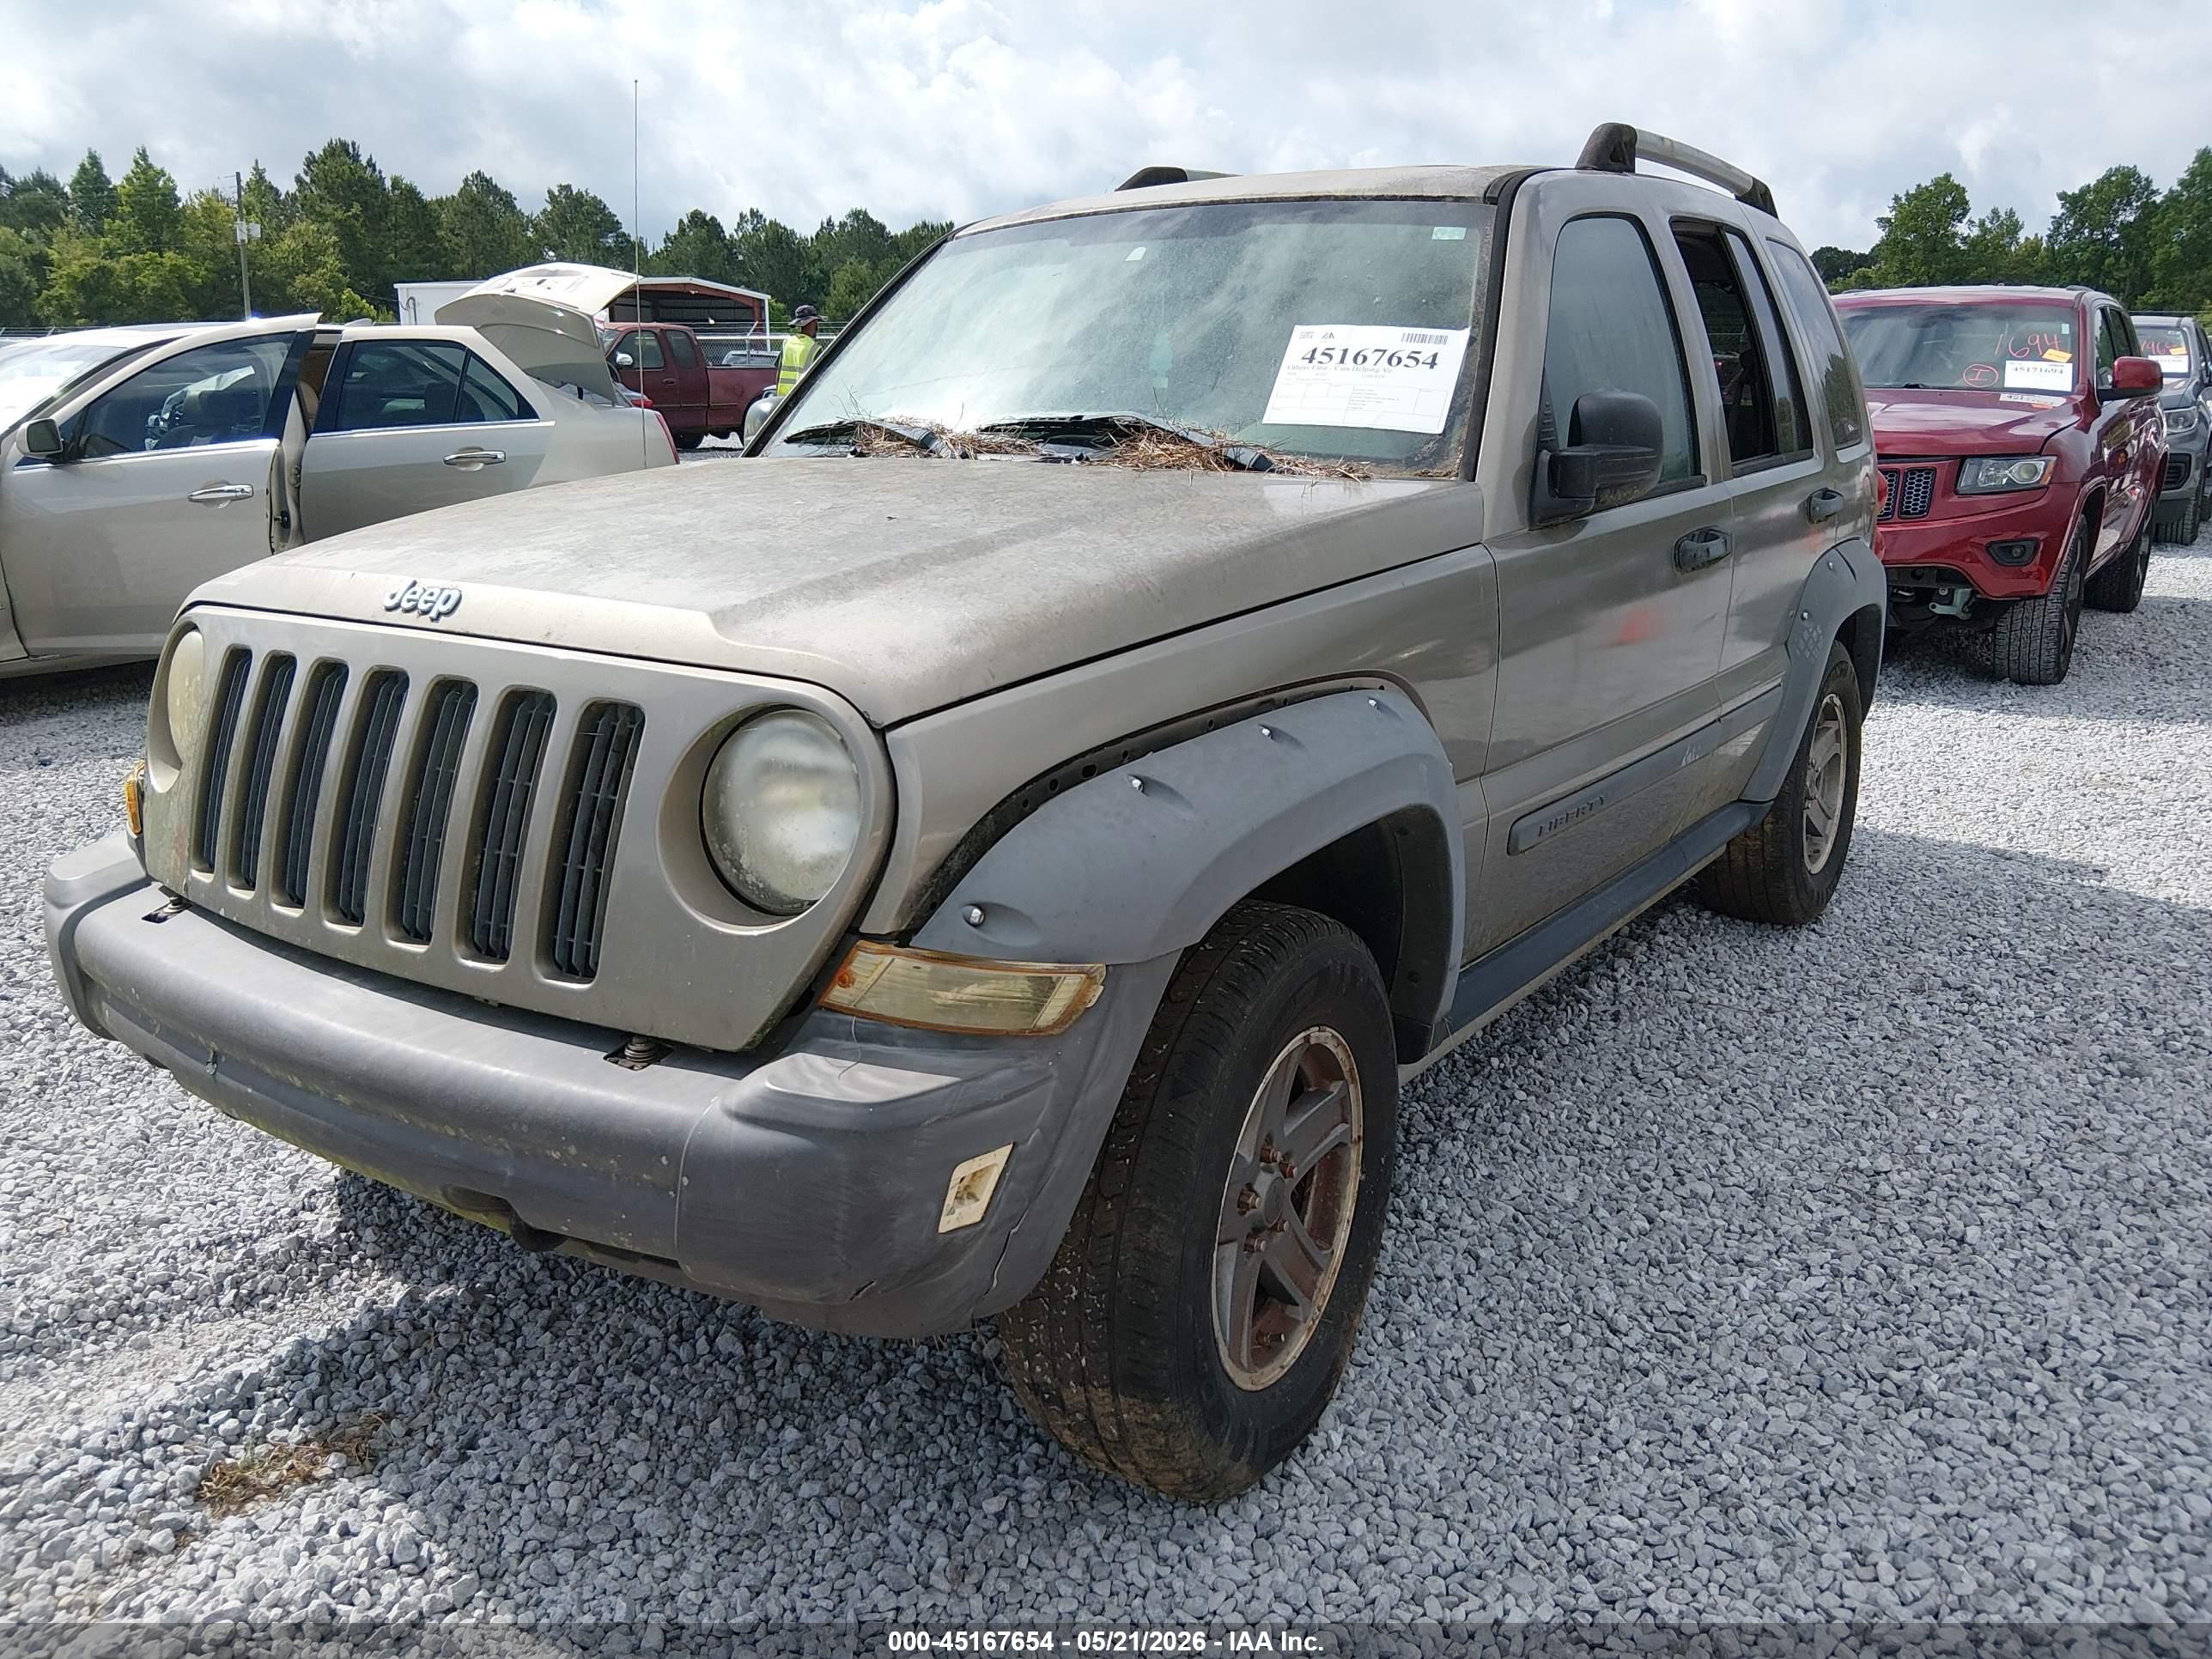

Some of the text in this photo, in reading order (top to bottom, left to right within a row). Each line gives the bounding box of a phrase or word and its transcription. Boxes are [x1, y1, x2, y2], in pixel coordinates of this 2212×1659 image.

[1301, 347, 1440, 369] 45167654
[1995, 333, 2062, 358] 1694
[383, 580, 462, 622] Jeep
